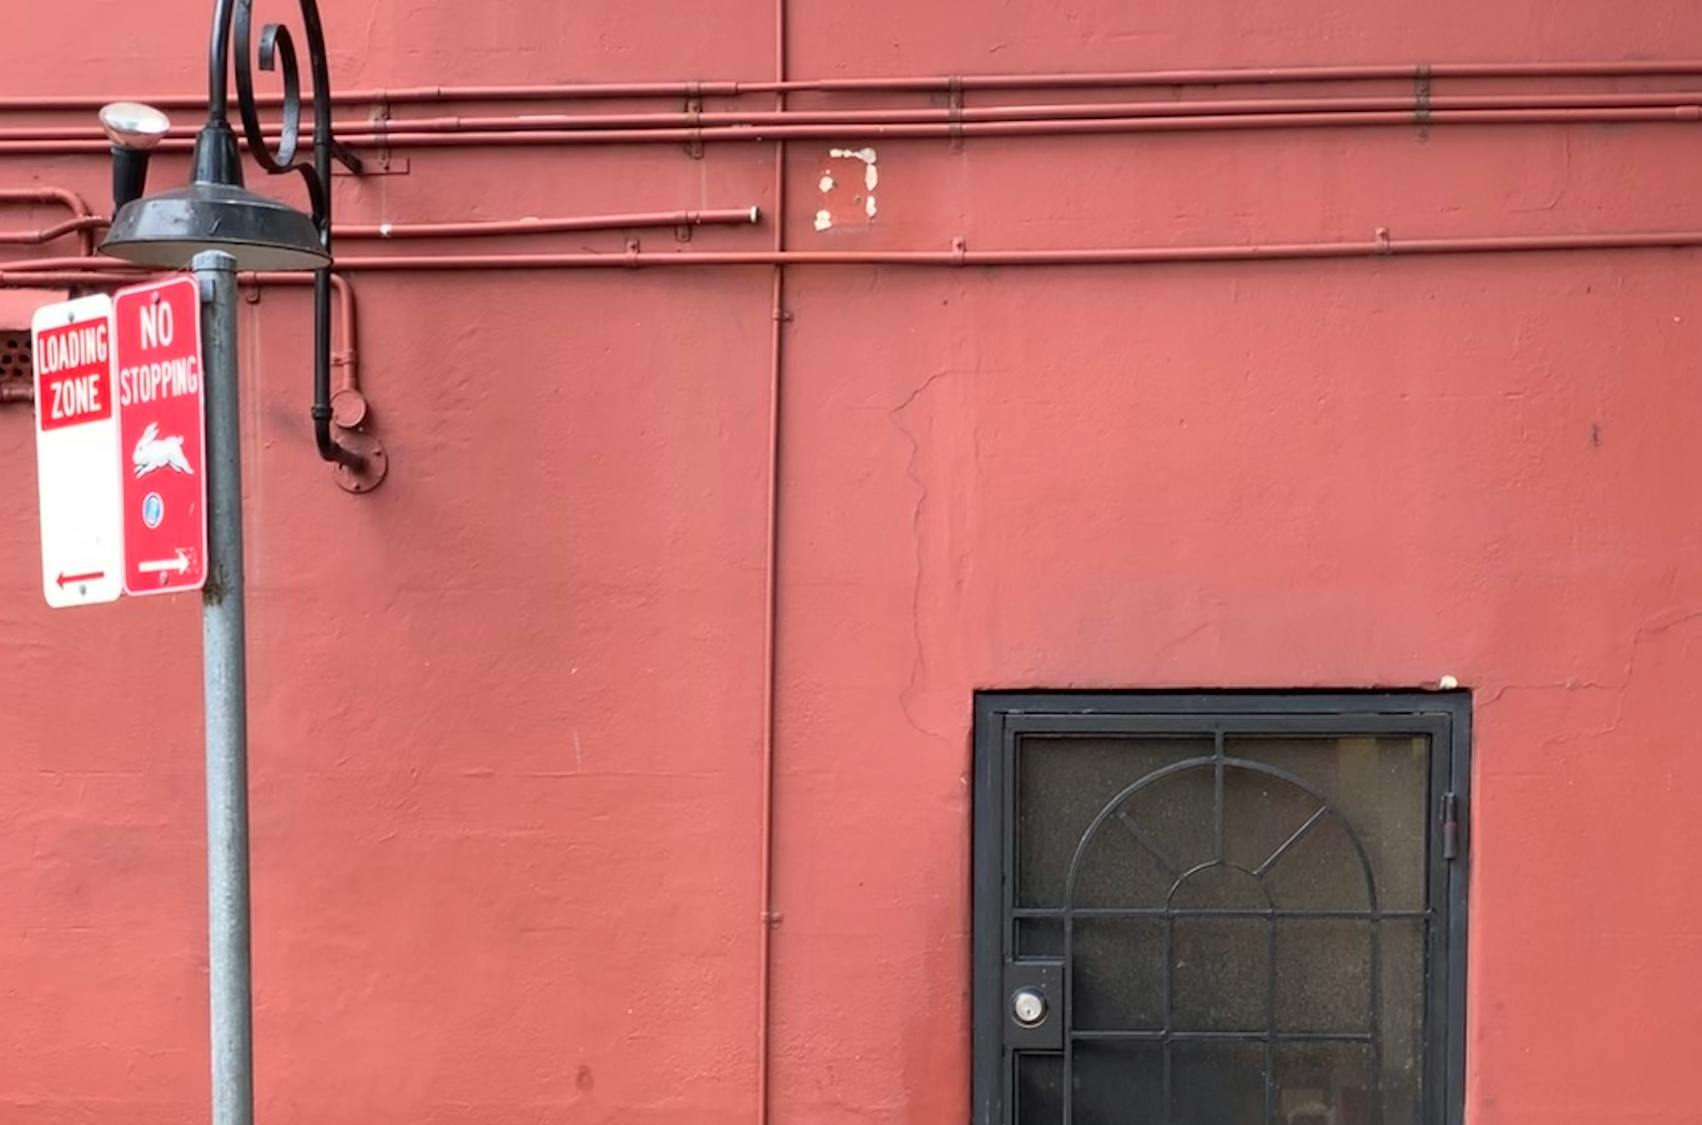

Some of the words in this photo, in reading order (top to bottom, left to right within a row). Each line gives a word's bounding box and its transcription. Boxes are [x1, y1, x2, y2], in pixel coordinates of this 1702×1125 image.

[39, 324, 107, 373] LOADING
[139, 301, 173, 349] NO
[50, 374, 101, 419] ZONE
[120, 355, 198, 406] STOPPING
